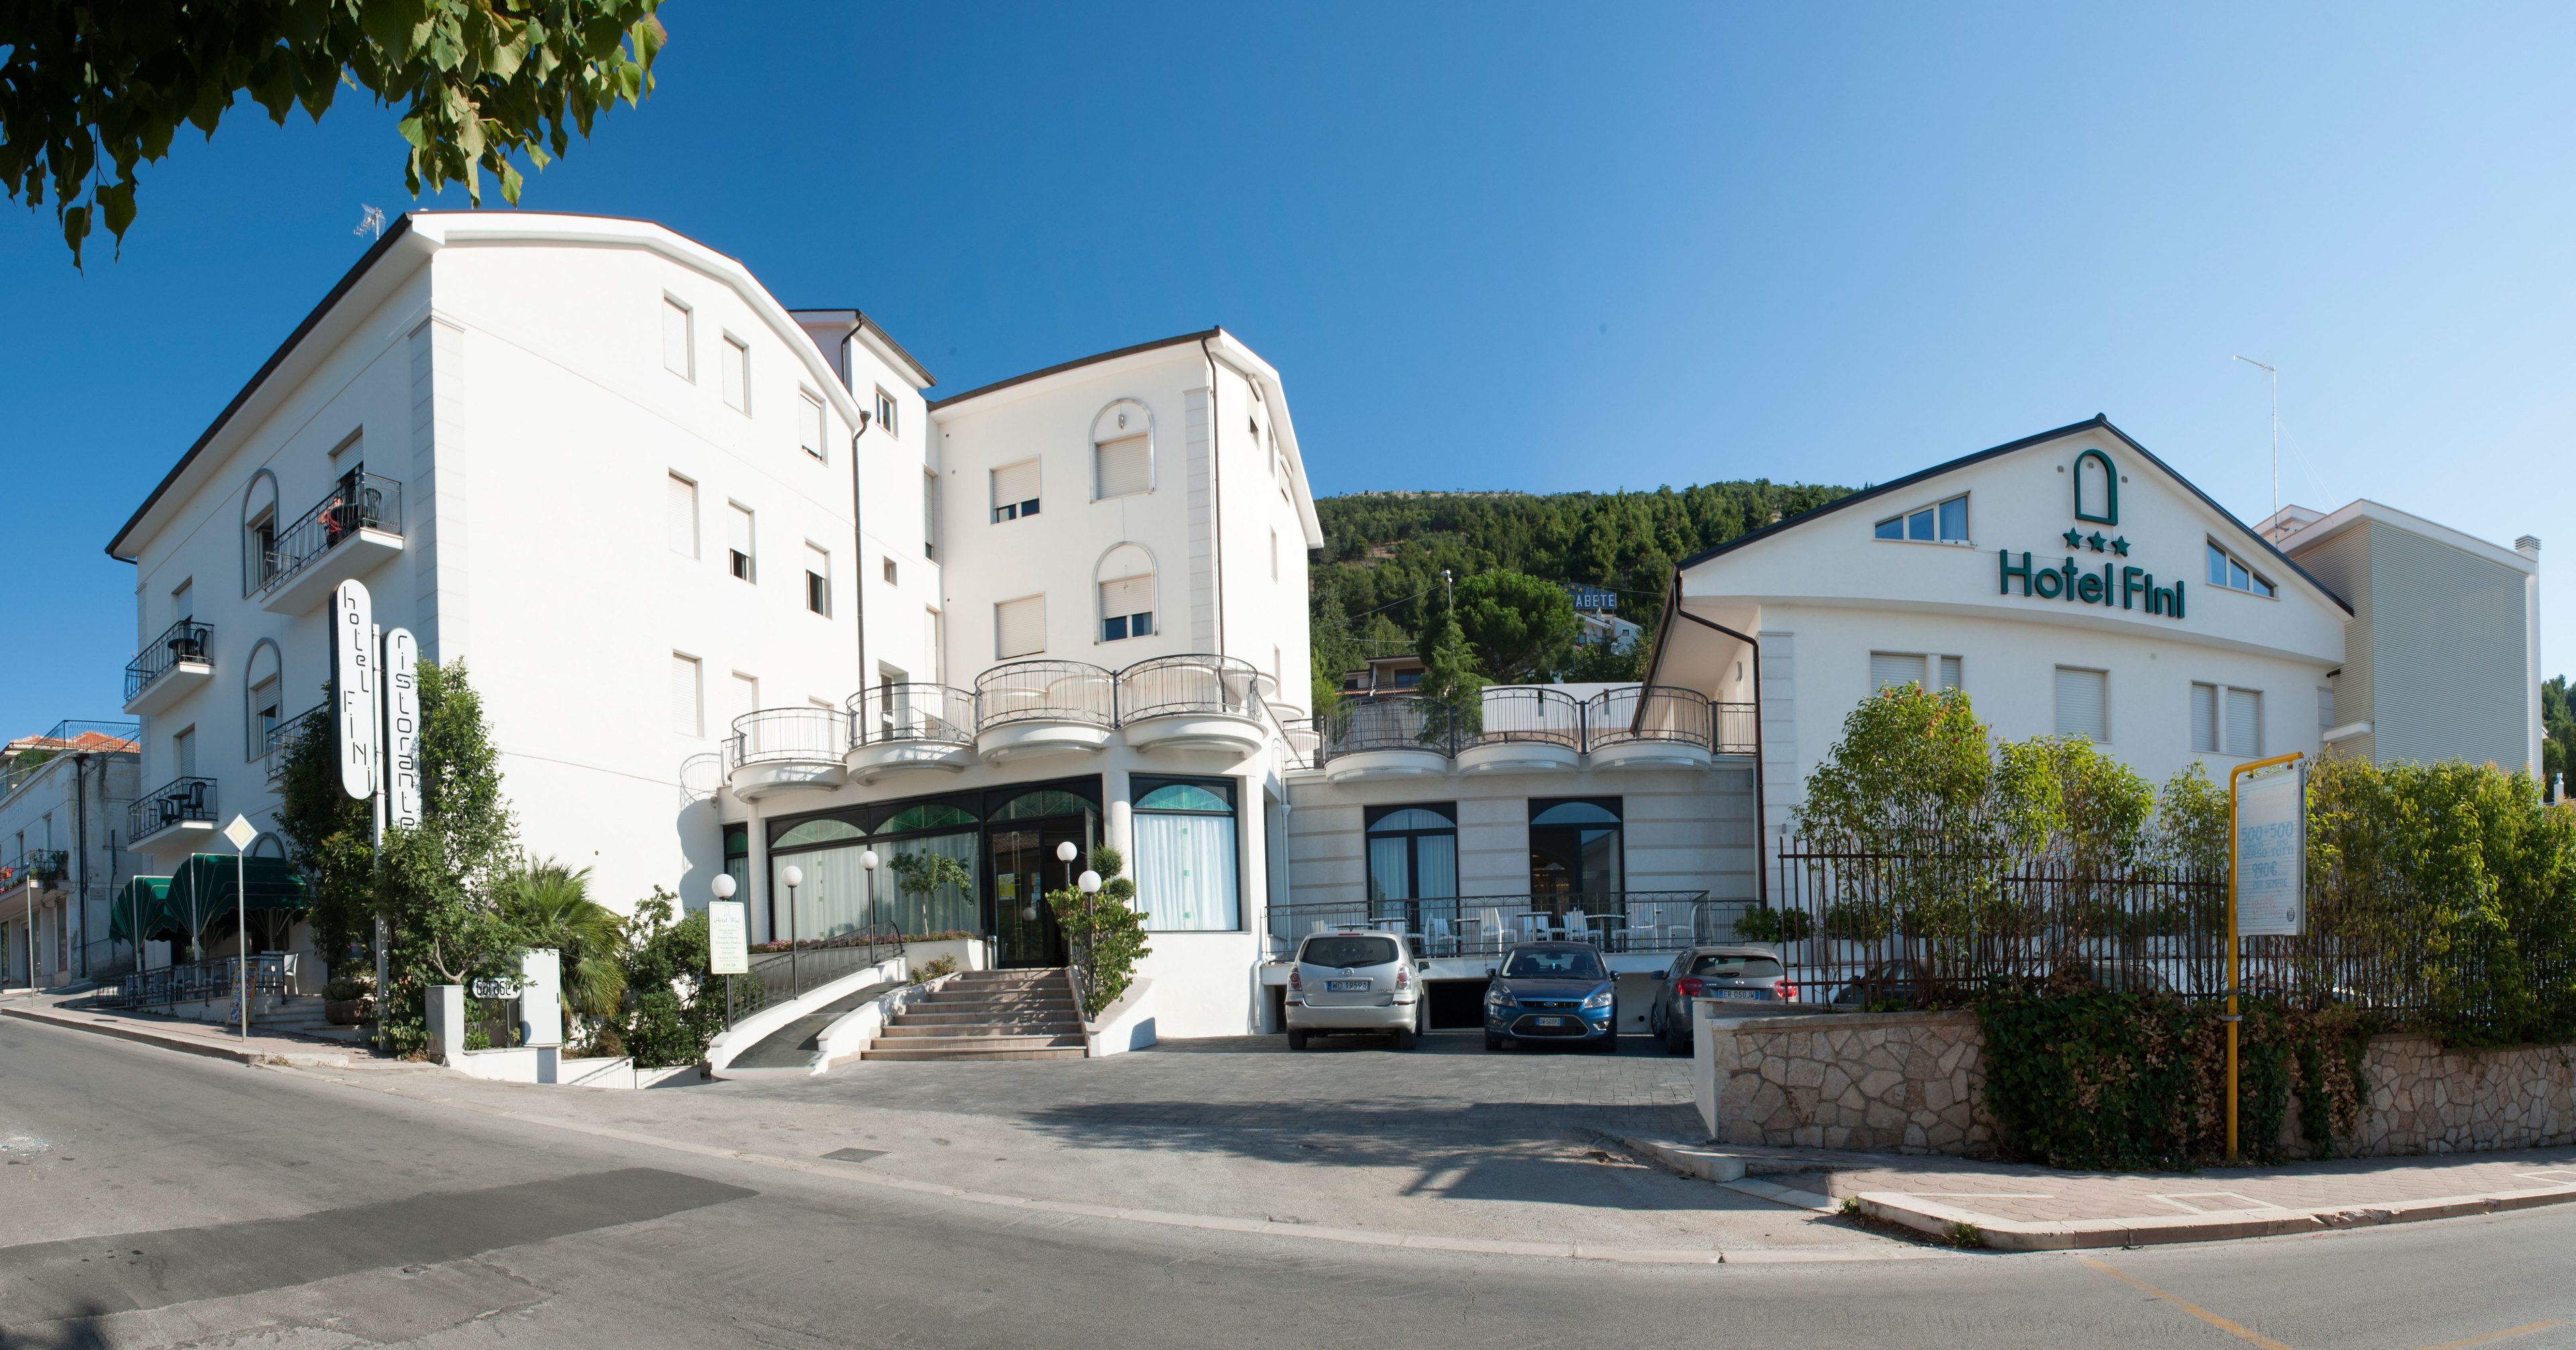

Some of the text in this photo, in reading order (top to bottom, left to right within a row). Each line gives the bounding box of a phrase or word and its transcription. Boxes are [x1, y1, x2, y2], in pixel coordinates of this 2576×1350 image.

[2000, 549, 2185, 619] Hotel Fini
[343, 585, 369, 693] hotel
[2241, 846, 2294, 860] VERSO TUTTI
